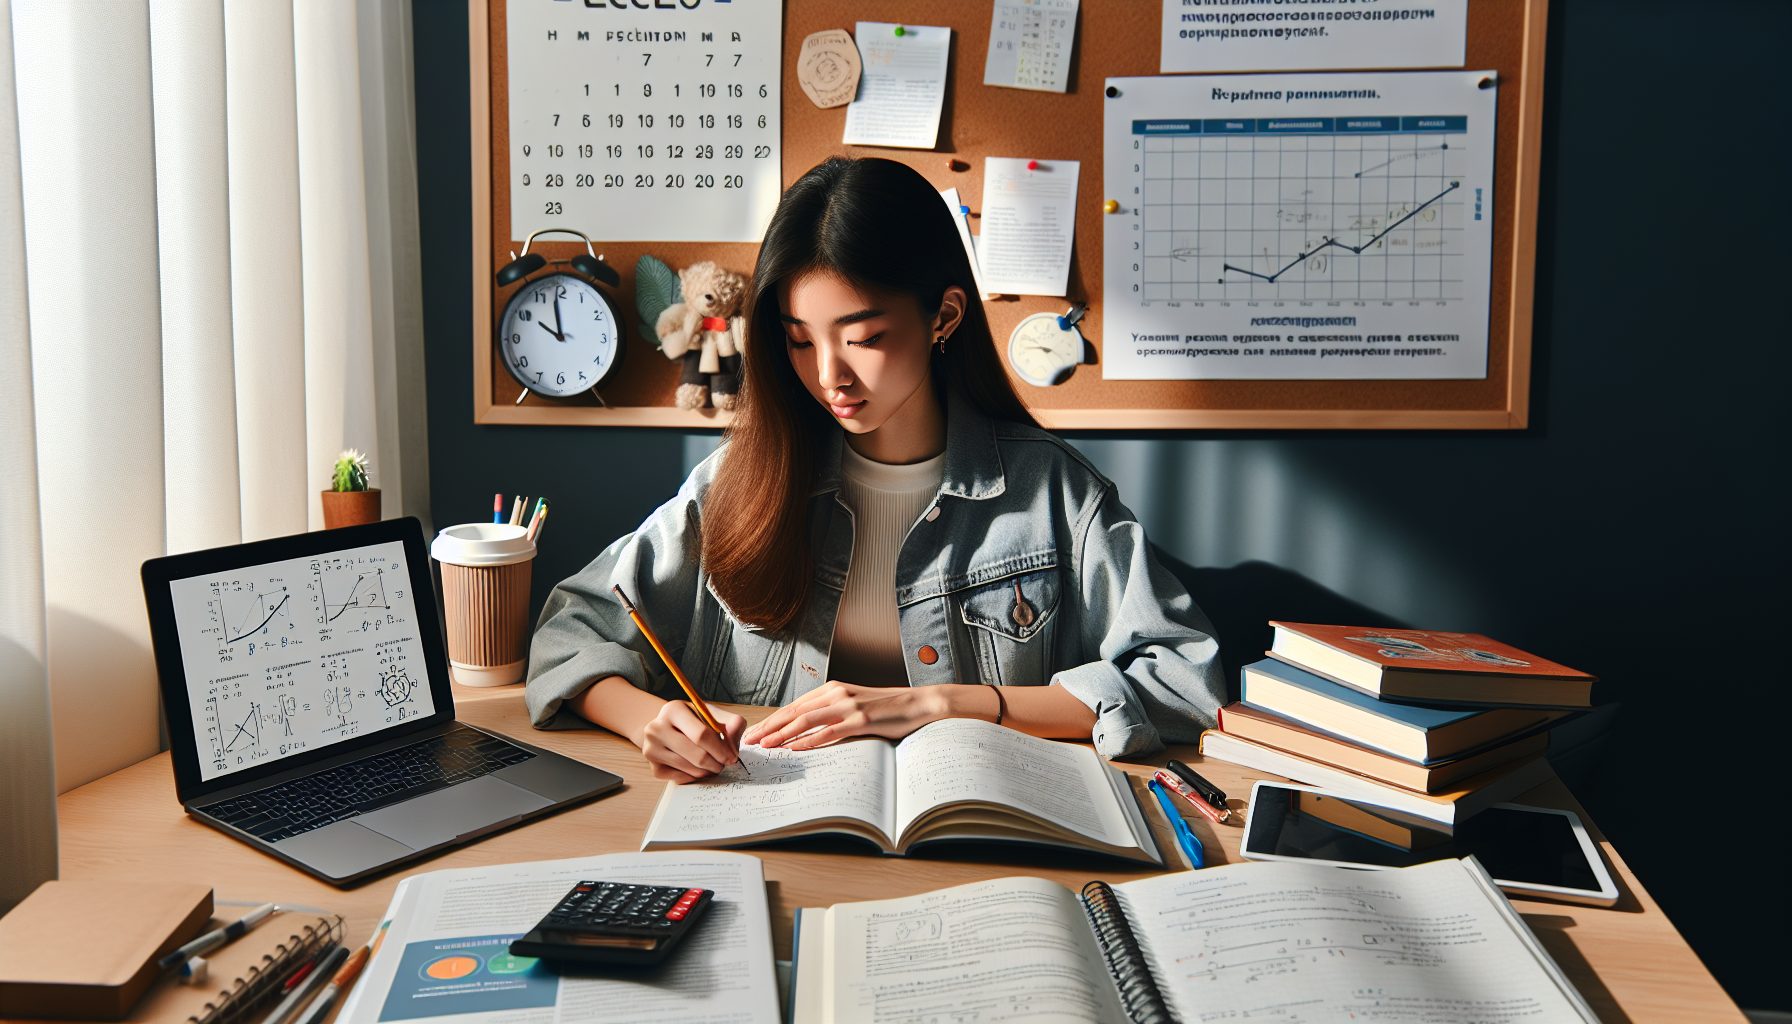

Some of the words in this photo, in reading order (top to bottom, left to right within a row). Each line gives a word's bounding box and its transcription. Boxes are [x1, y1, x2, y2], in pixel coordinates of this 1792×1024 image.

[547, 29, 558, 41] H
[642, 53, 652, 67] 7
[705, 53, 714, 68] 7
[733, 53, 743, 68] 7
[583, 83, 590, 97] 1
[613, 83, 620, 97] 1
[674, 83, 680, 98] 1
[758, 84, 768, 99] 6
[552, 113, 561, 127] 7
[575, 173, 595, 188] 20
[634, 174, 655, 188] 20
[665, 174, 685, 189] 20
[694, 174, 715, 189] 20
[724, 174, 744, 189] 20
[600, 333, 607, 344] 3
